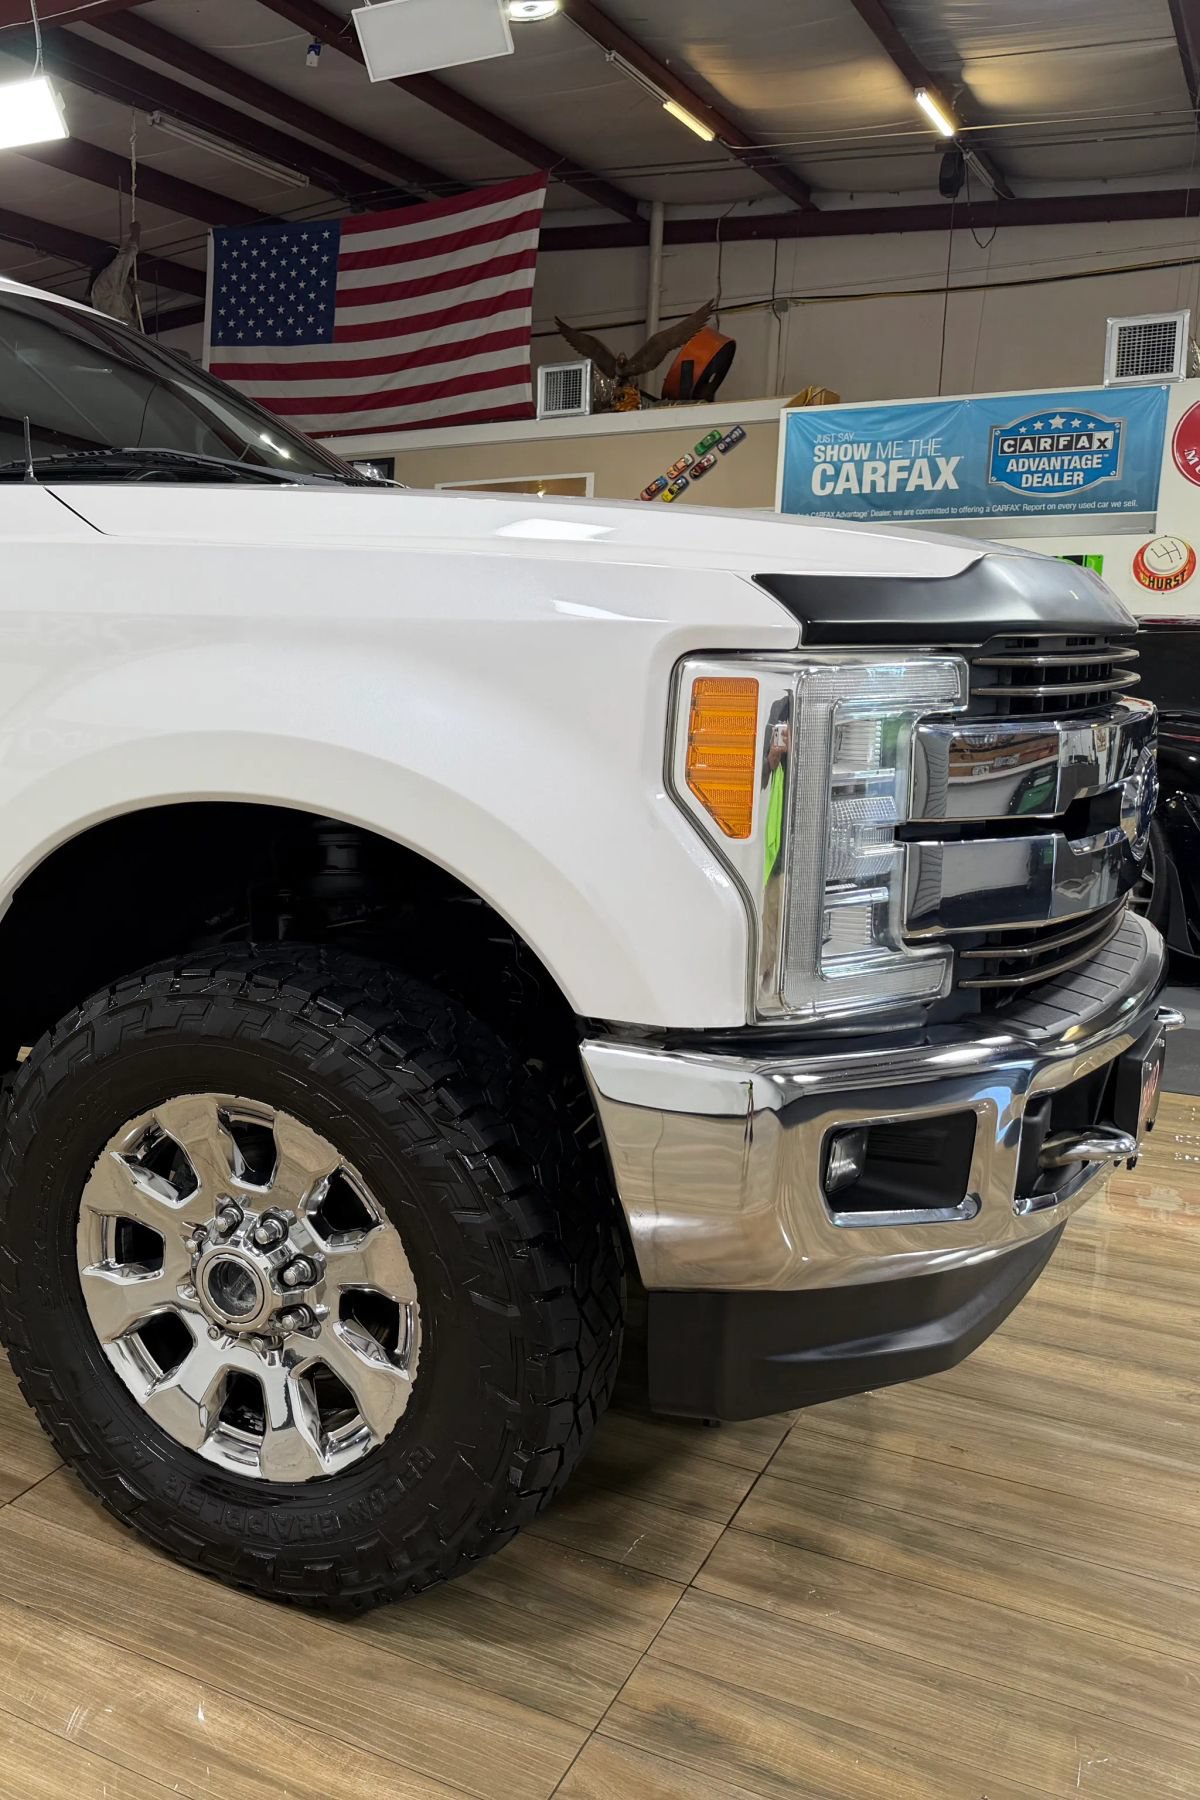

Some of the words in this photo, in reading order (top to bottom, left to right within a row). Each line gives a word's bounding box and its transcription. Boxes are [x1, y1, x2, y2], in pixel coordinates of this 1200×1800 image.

[813, 433, 835, 444] JUST
[838, 432, 854, 441] SAY
[1002, 435, 1110, 453] CARFAX
[813, 443, 871, 462] SHOW
[875, 440, 904, 459] ME
[908, 438, 943, 456] THE
[811, 456, 961, 496] CARFAX
[1021, 471, 1085, 488] DEALER
[915, 507, 950, 515] committed
[959, 505, 984, 514] offering
[1022, 503, 1045, 513] Report
[1057, 503, 1077, 511] every
[1078, 501, 1096, 509] used
[1148, 569, 1187, 590] HURST
